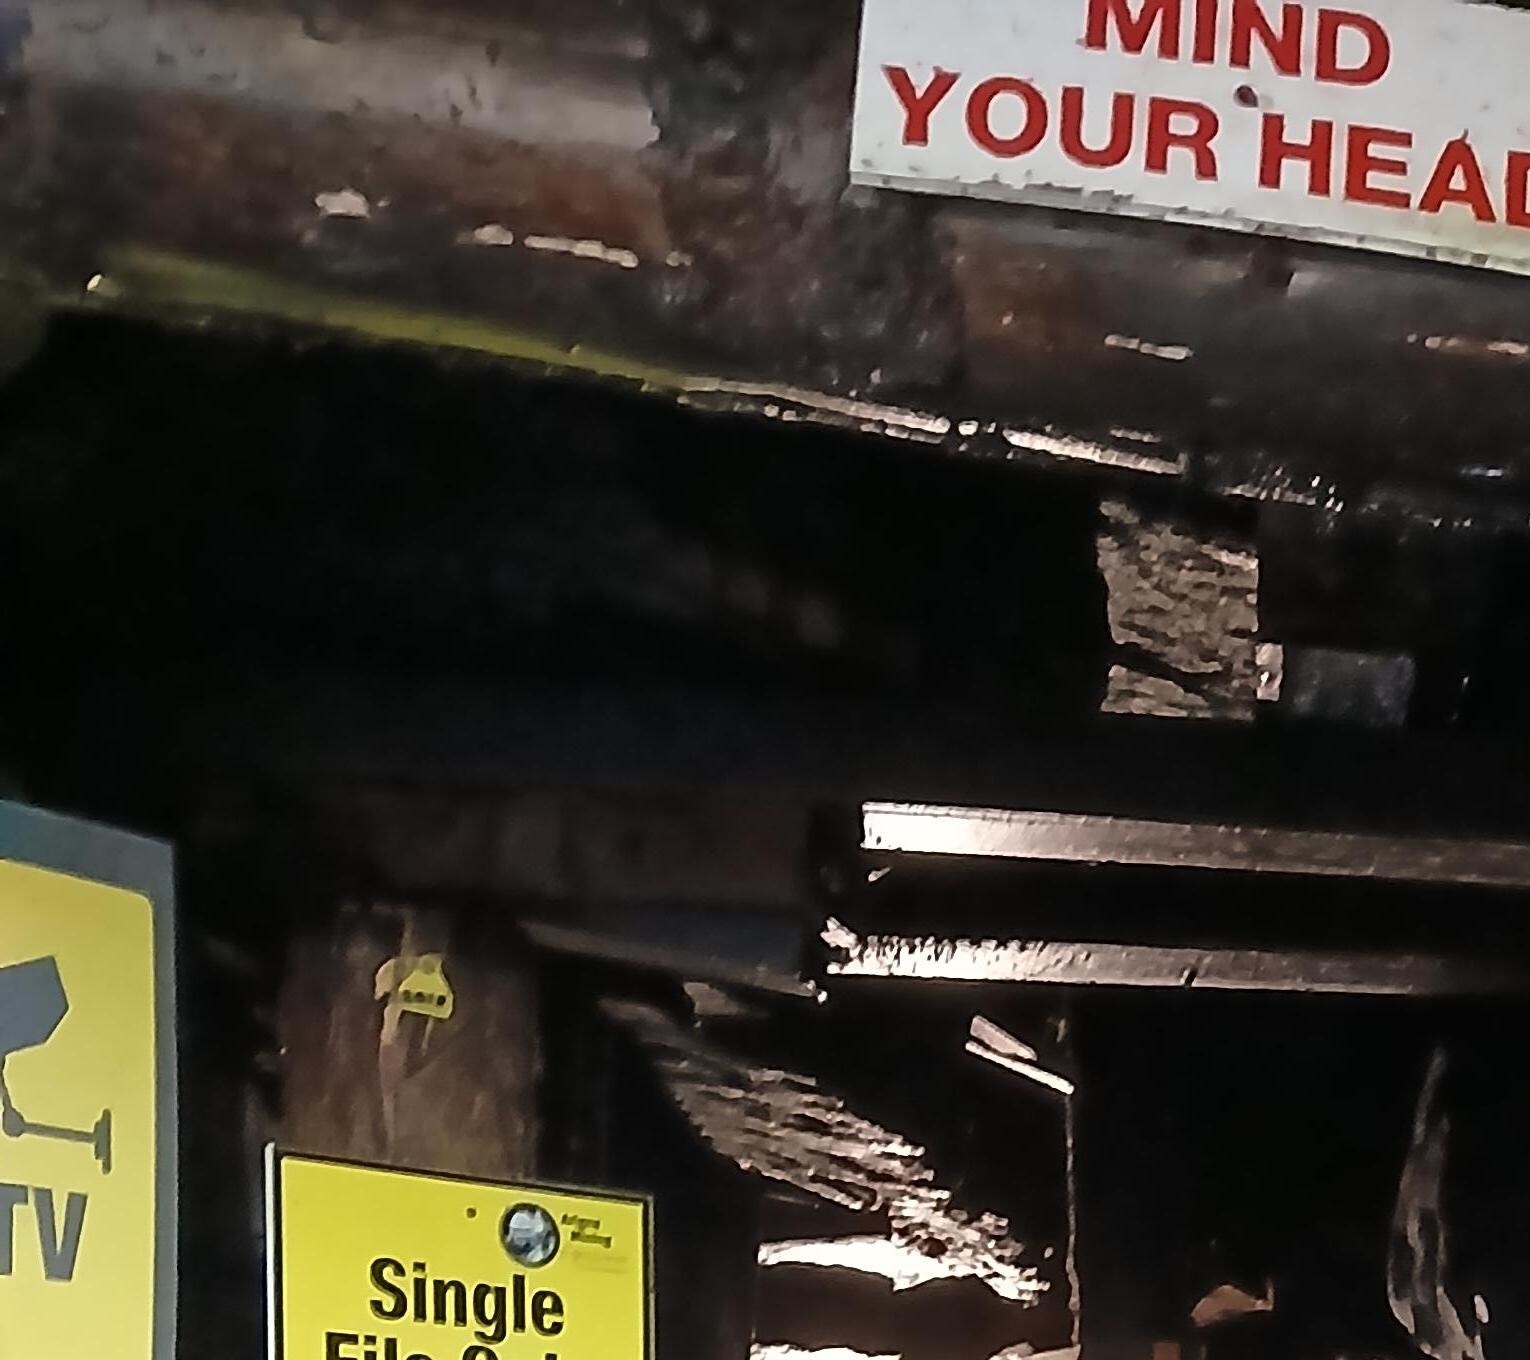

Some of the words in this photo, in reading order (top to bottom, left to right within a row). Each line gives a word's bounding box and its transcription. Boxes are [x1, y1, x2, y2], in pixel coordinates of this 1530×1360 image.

[1085, 0, 1390, 86] MIND
[881, 64, 1218, 181] YOUR
[369, 1257, 564, 1344] Single
